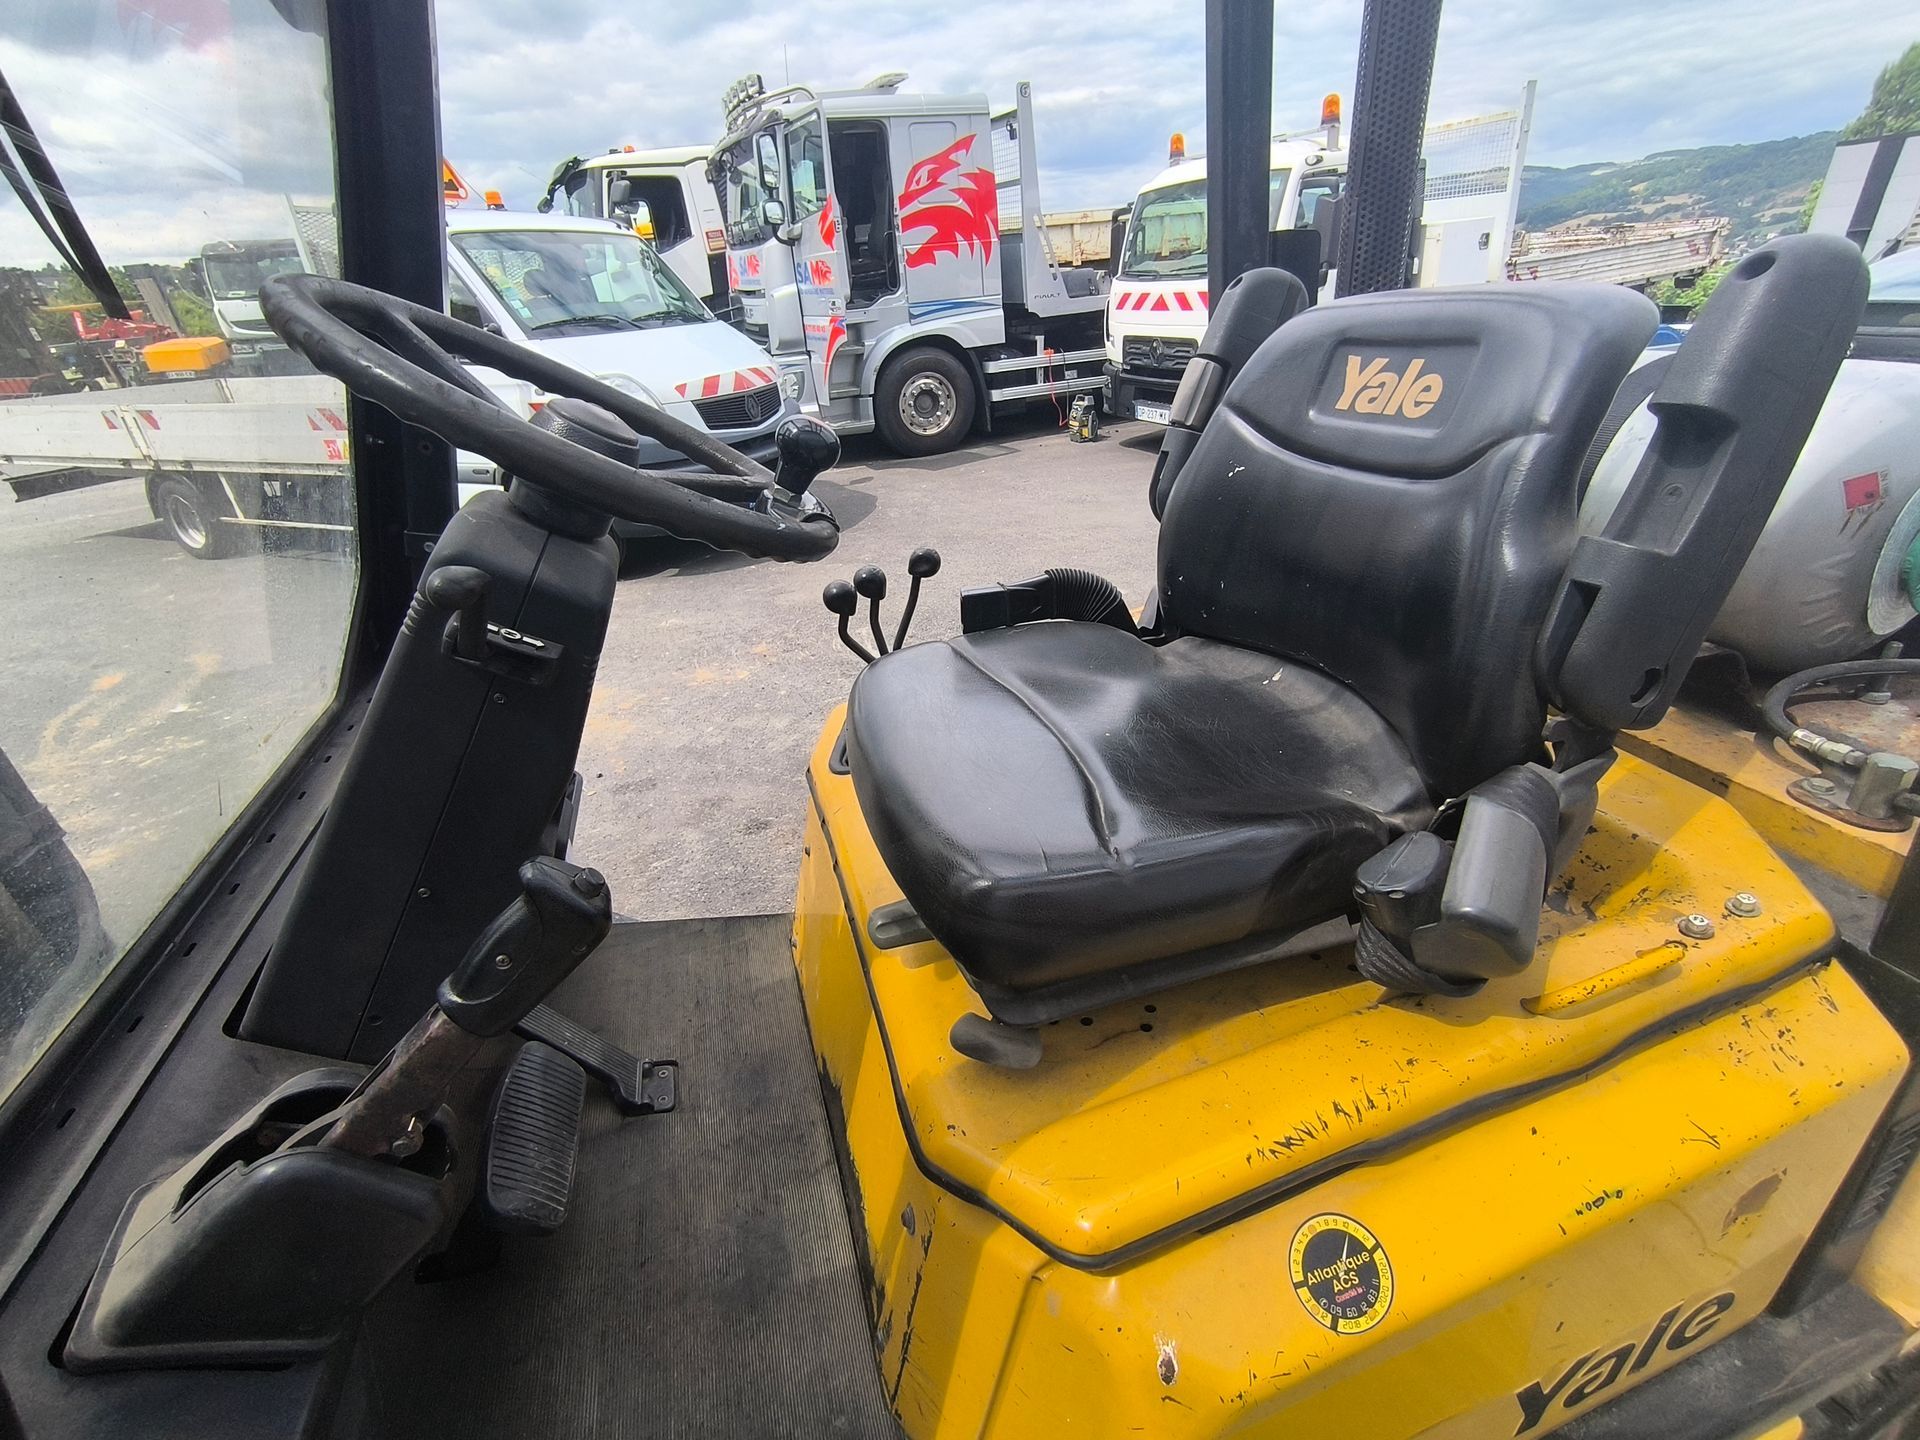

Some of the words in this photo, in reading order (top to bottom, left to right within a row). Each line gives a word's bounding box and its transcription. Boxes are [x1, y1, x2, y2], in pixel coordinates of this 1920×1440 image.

[1335, 355, 1443, 419] Yale
[1307, 1251, 1370, 1286] Atlantique
[1333, 1271, 1359, 1293] ACS
[1330, 1304, 1342, 1316] 09
[1346, 1306, 1358, 1318] 60
[1360, 1301, 1369, 1312] 12
[1367, 1289, 1378, 1302] 83
[1513, 1290, 1736, 1437] Yale
